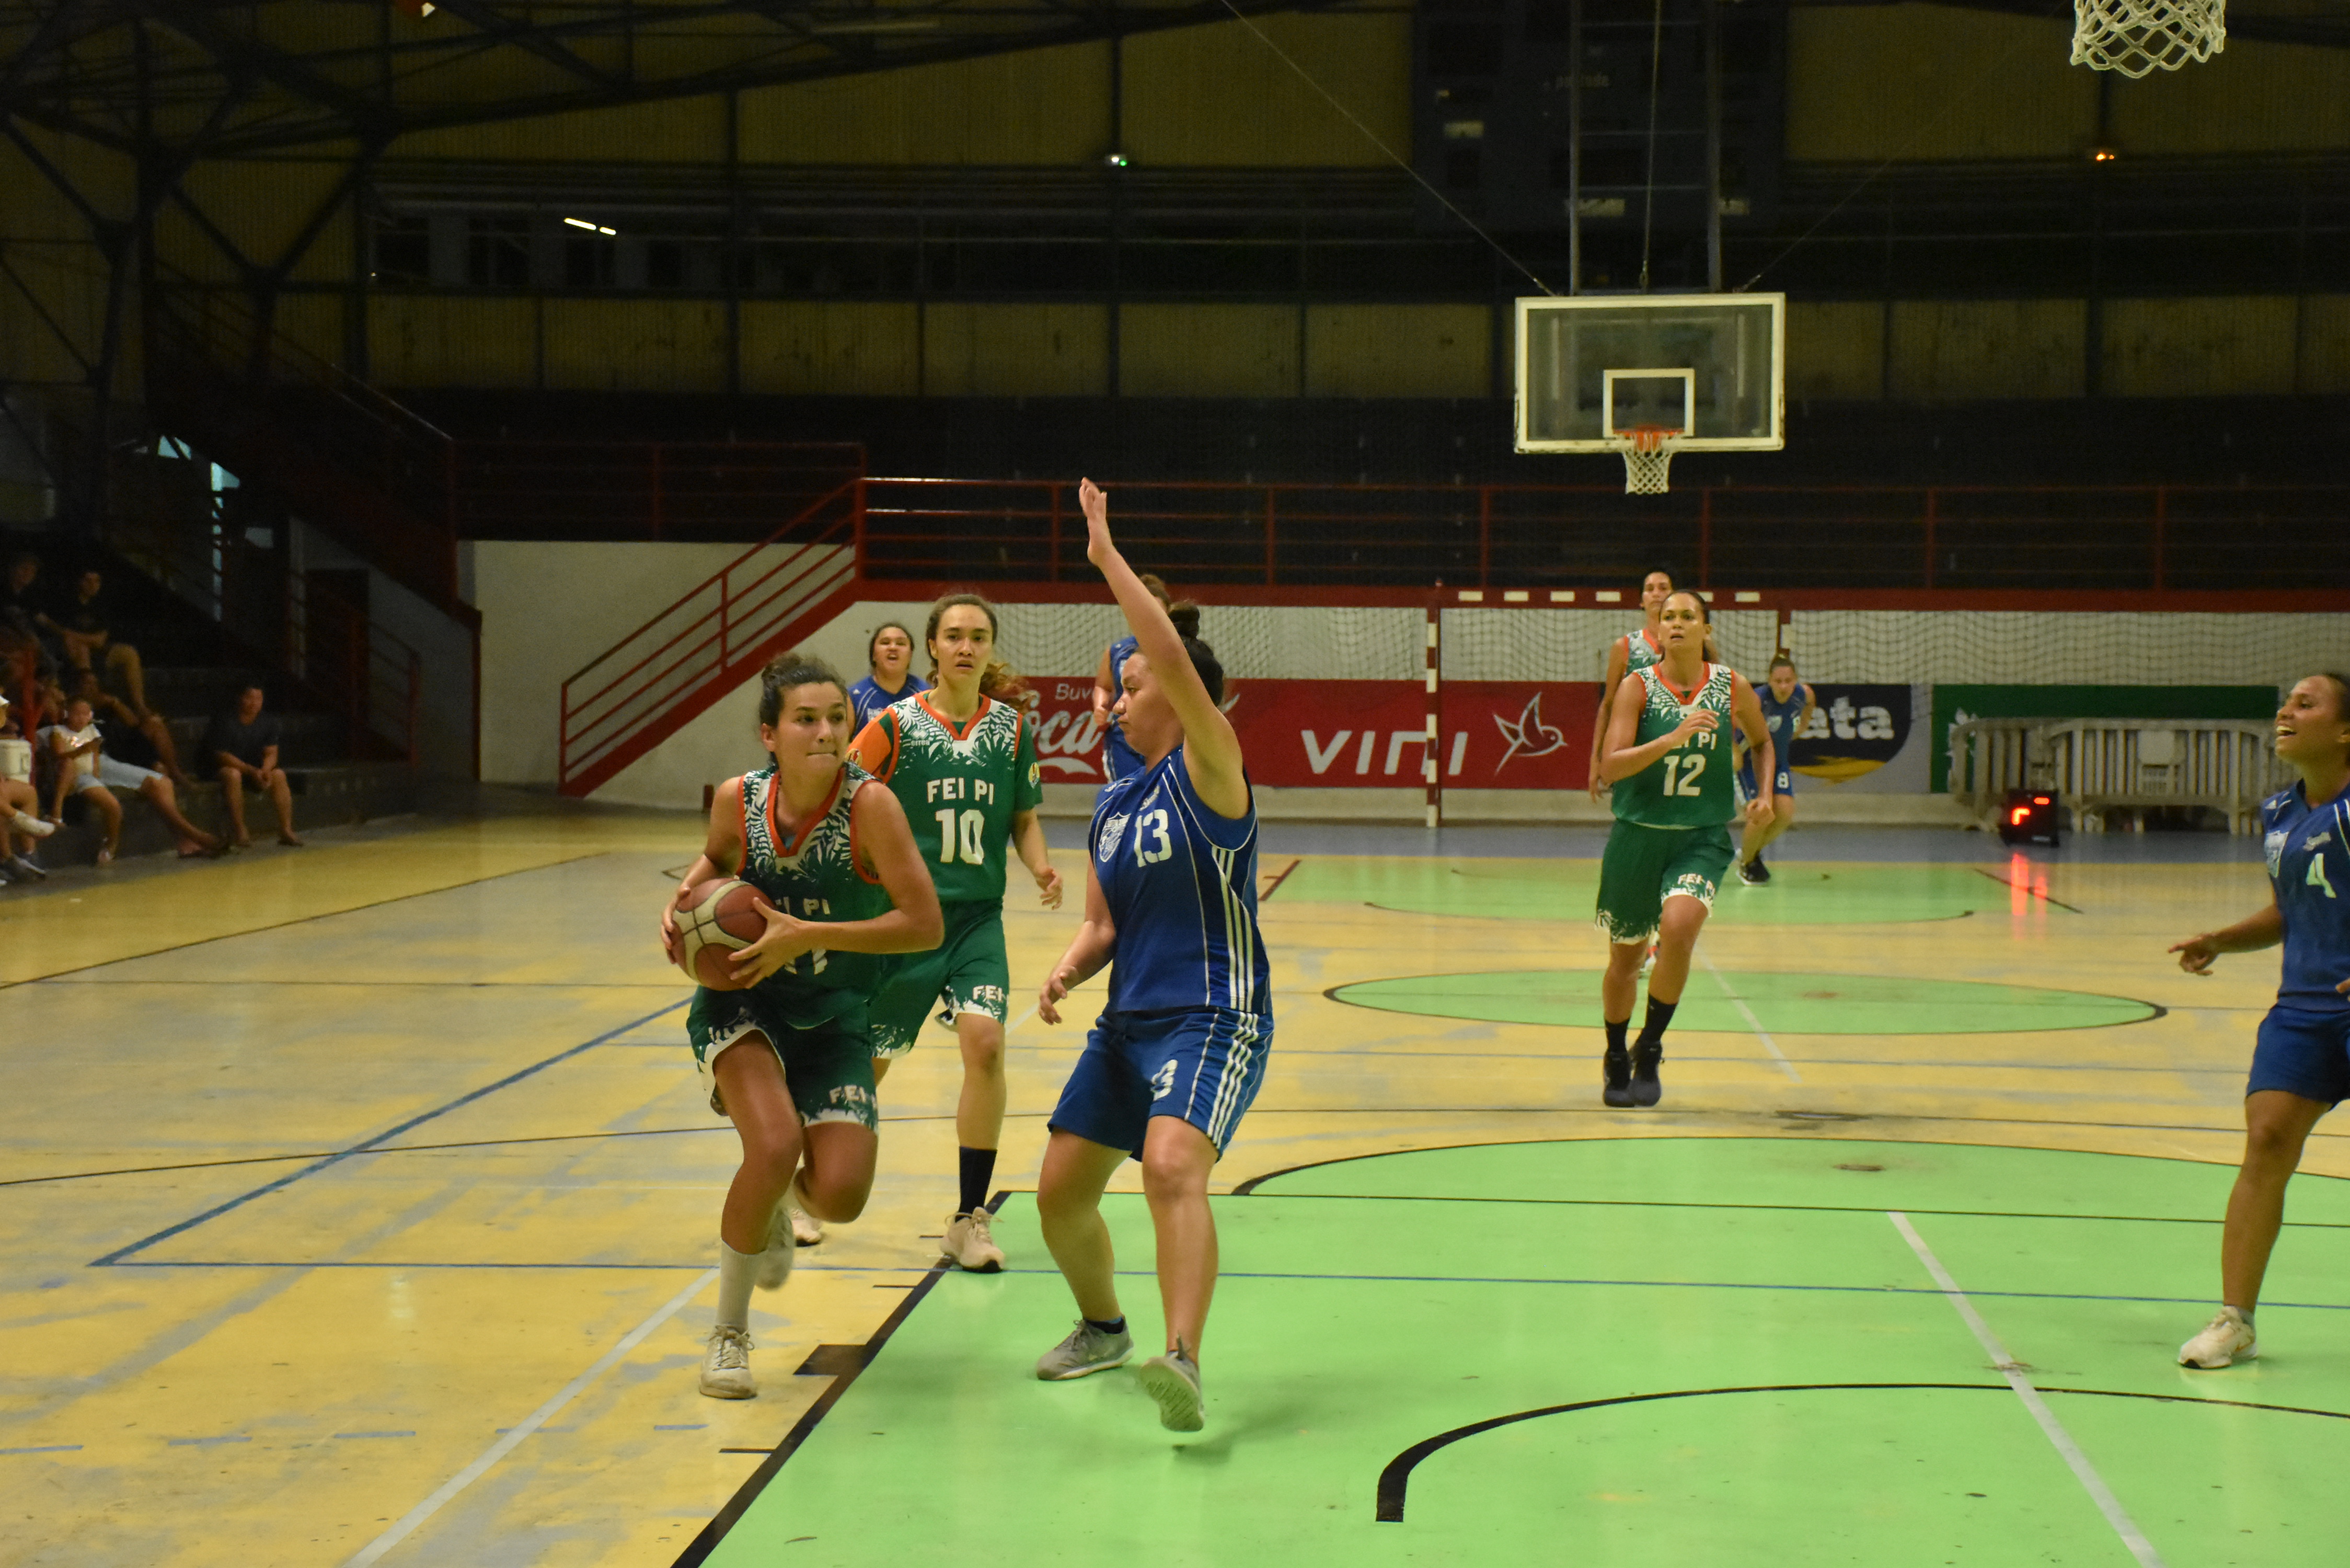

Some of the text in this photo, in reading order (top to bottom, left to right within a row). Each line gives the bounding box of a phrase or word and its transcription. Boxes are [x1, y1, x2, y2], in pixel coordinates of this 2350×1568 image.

[1055, 683, 1095, 701] Buv
[1798, 695, 1895, 740] ata
[1698, 731, 1717, 751] PI
[1663, 754, 1707, 797] 12
[927, 777, 994, 805] FEI PI
[935, 808, 985, 866] 10
[1133, 808, 1172, 868] 13
[2305, 852, 2337, 899] 4
[803, 897, 831, 916] PI
[973, 985, 1003, 1003] FEI
[830, 1085, 867, 1104] FEI
